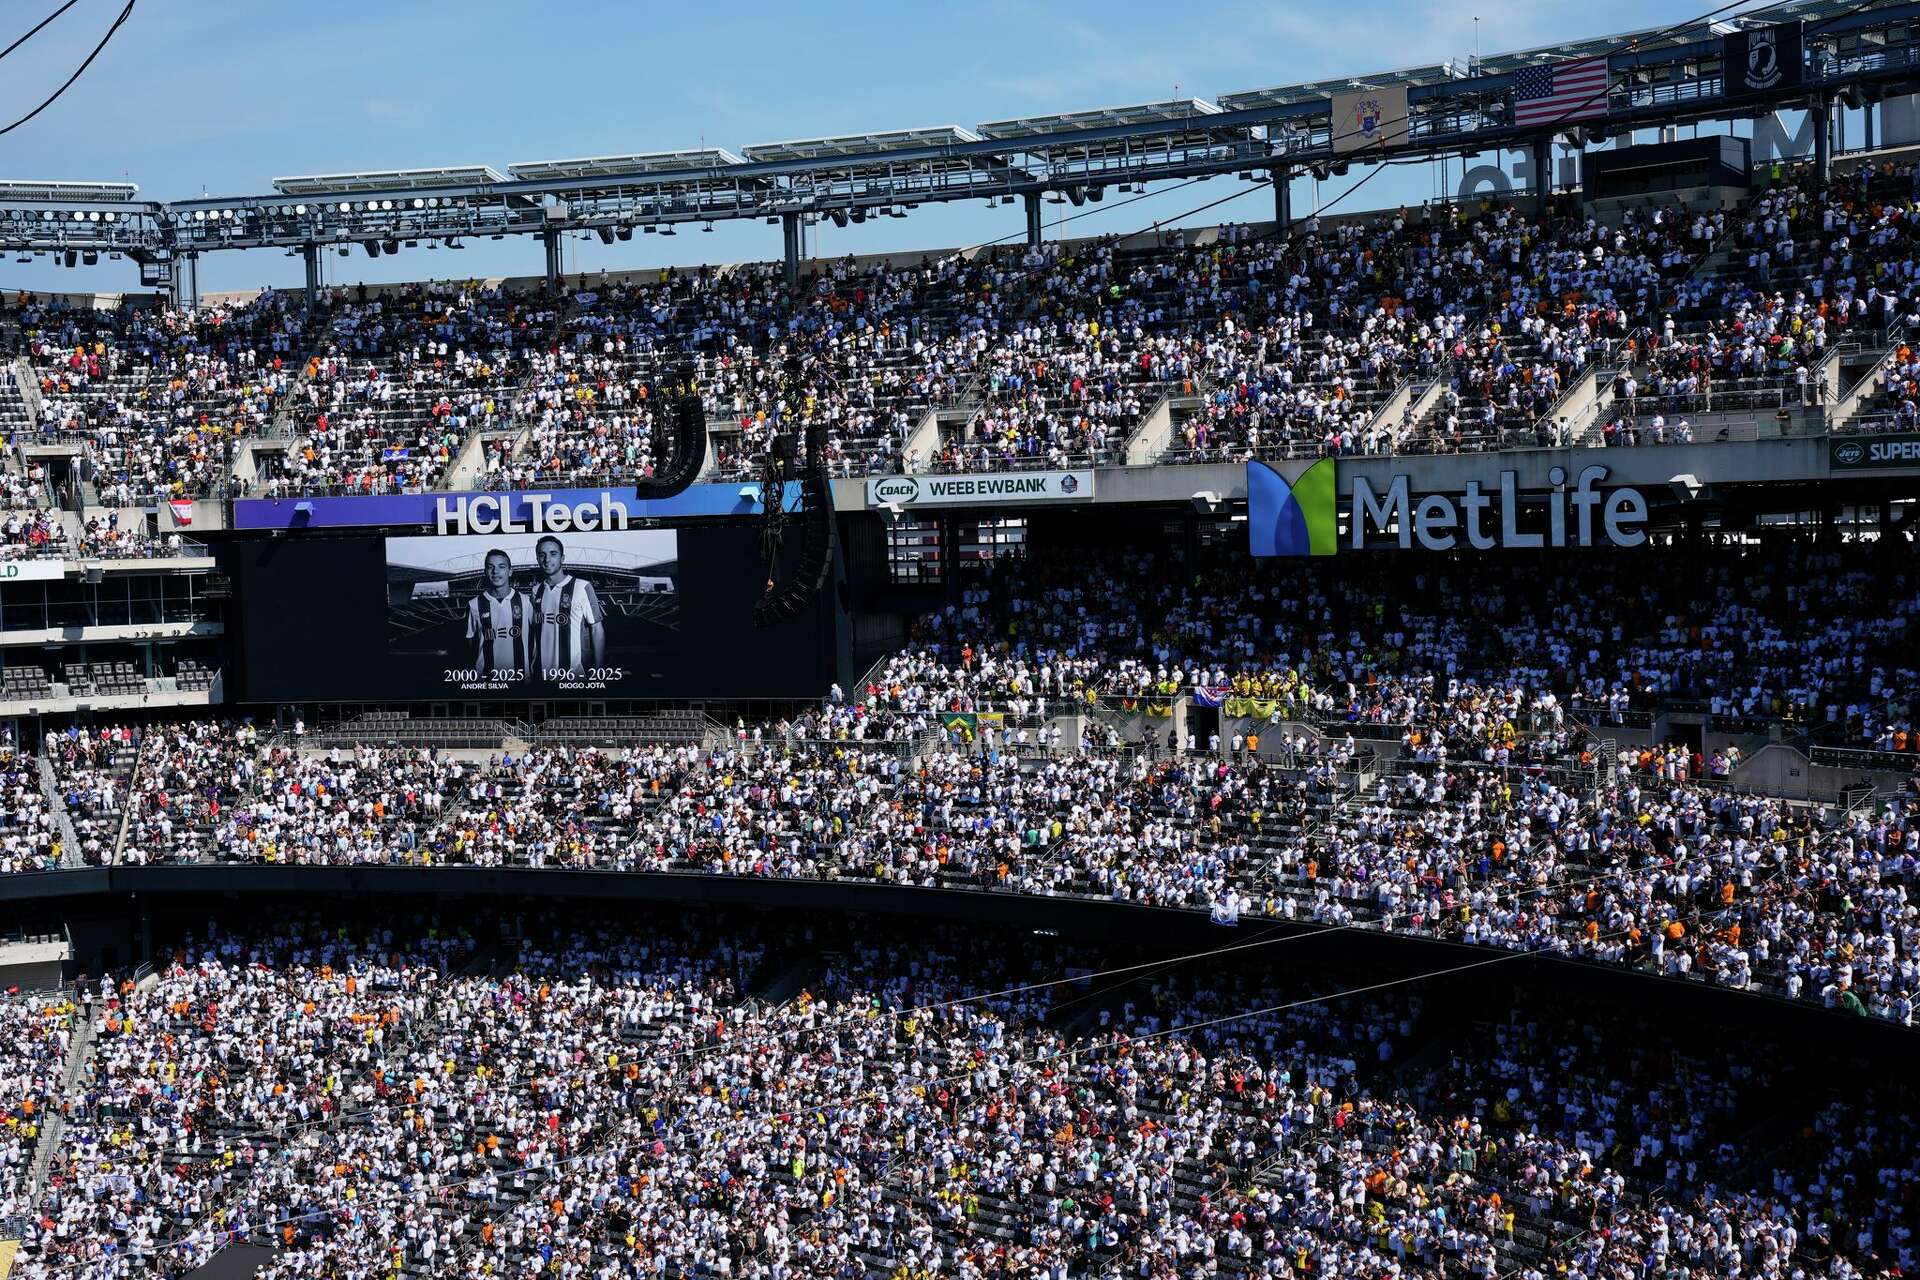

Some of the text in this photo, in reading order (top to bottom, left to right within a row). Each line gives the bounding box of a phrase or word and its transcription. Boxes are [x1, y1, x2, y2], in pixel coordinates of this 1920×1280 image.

[1870, 441, 1920, 460] SUPER
[879, 485, 914, 496] COACH
[930, 481, 975, 496] WEEB
[977, 478, 1046, 494] EWBANK
[436, 492, 628, 535] HCLTech
[1352, 465, 1649, 551] MetLife
[443, 669, 478, 682] 2000
[491, 668, 524, 682] 2025
[542, 668, 575, 681] 1996
[588, 667, 623, 681] 2025
[461, 681, 487, 689] ANDRÉ
